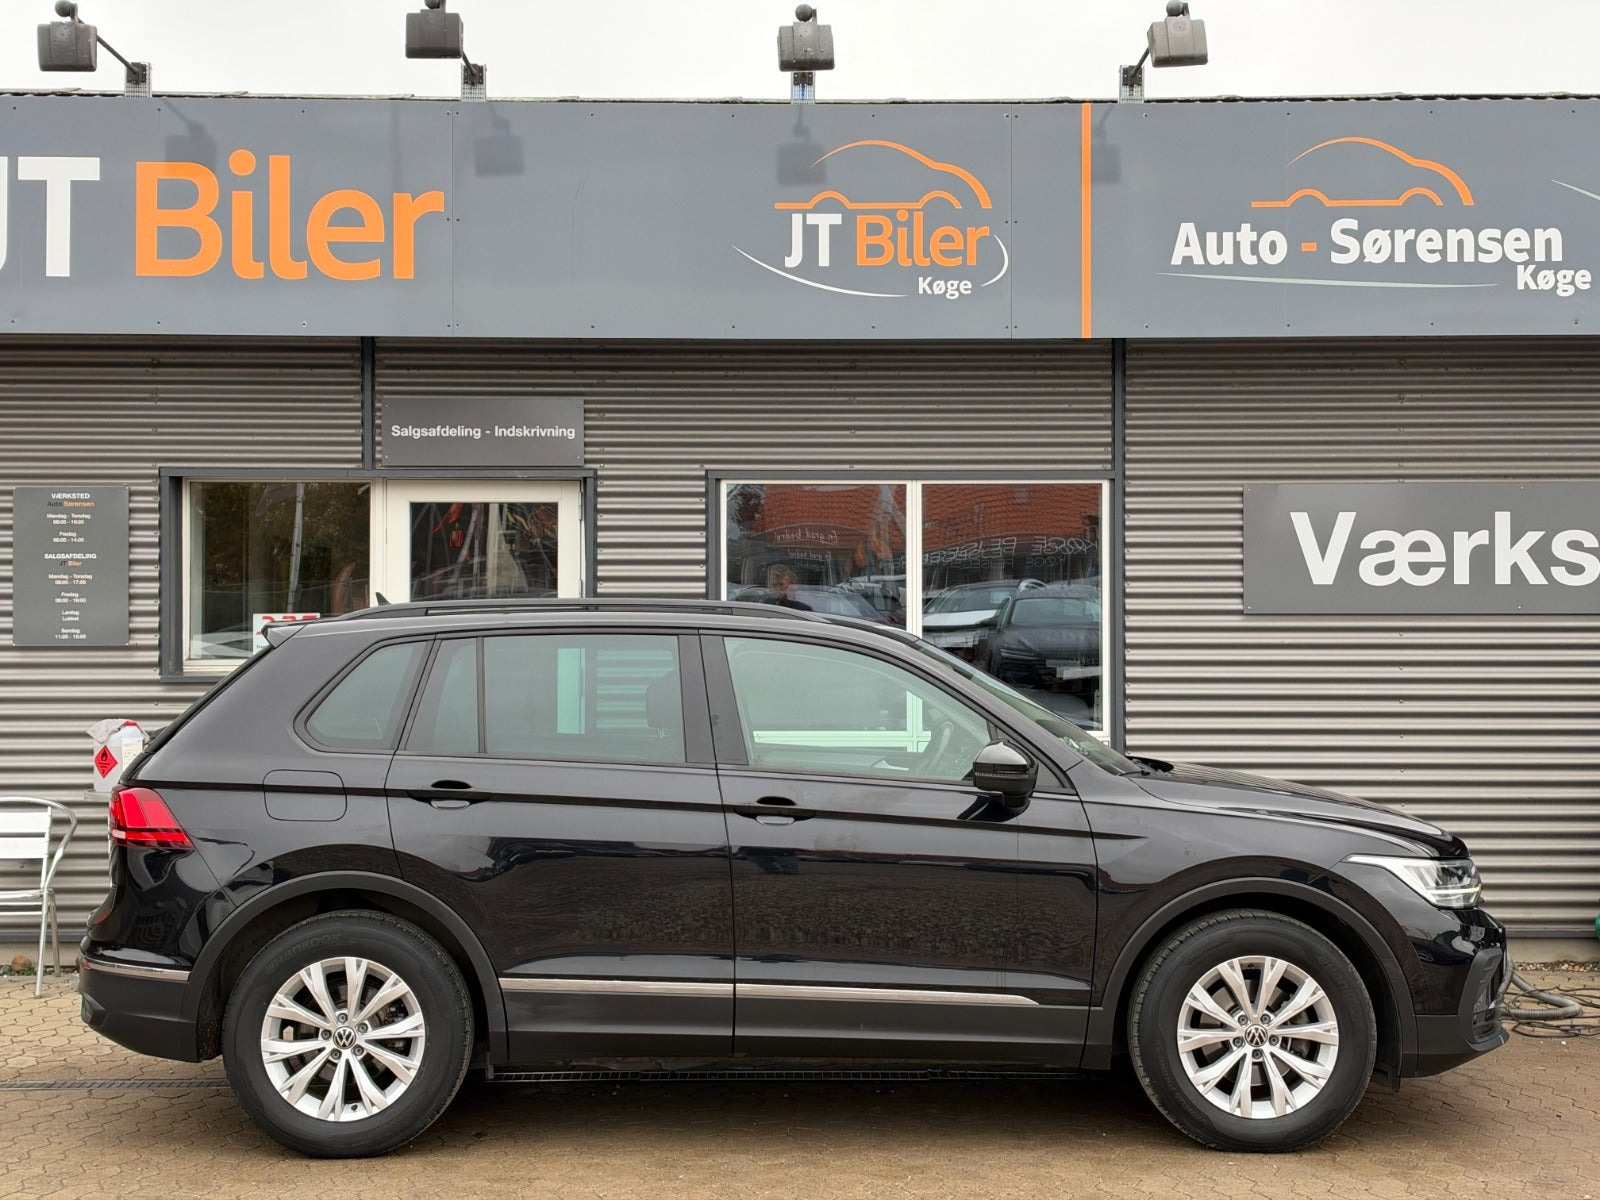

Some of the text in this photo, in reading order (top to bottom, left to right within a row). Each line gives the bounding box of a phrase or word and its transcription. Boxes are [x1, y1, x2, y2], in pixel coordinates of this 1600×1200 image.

[0, 149, 445, 281] T Biler
[785, 209, 990, 267] JT Biler
[1170, 217, 1563, 265] Auto - Sørensen
[918, 276, 972, 299] Køge
[1516, 264, 1592, 297] Køge
[391, 424, 481, 439] Salgsafdeling
[494, 424, 576, 439] Indskrivning
[1289, 511, 1600, 586] Værks
